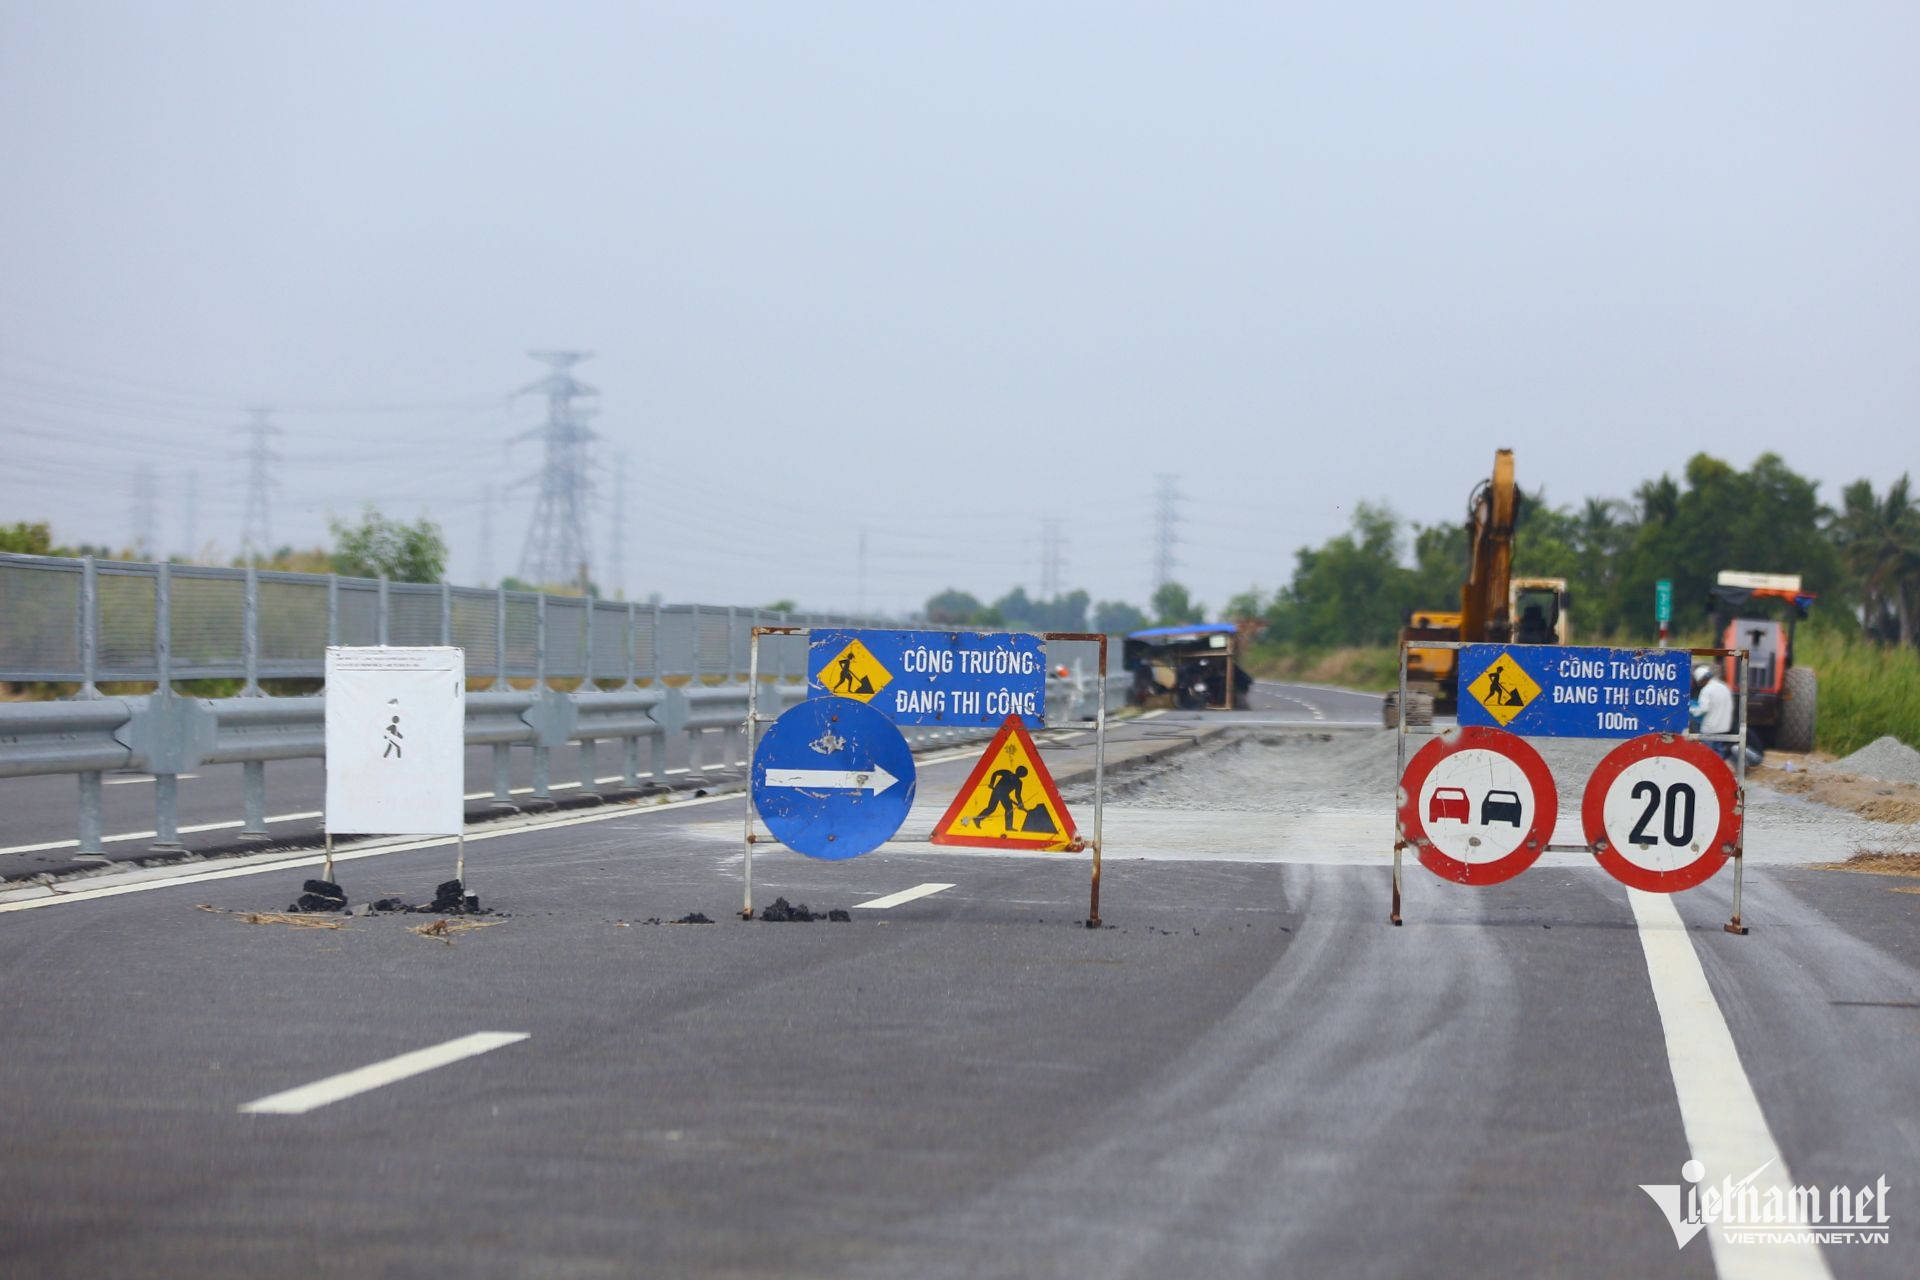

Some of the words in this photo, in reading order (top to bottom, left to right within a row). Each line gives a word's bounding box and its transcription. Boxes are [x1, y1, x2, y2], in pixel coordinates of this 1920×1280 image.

[904, 646, 953, 673] CÔNG
[959, 646, 1033, 674] TRƯỜNG
[1559, 655, 1604, 679] CÔNG
[1610, 657, 1677, 681] TRƯỜNG
[895, 690, 945, 714] ĐANG
[951, 692, 980, 714] THI
[986, 688, 1036, 715] CÔNG
[1553, 685, 1598, 704] ĐANG
[1603, 686, 1629, 705] THI
[1634, 685, 1680, 706] CÔNG
[1596, 712, 1638, 731] 100m
[1628, 780, 1696, 846] 20
